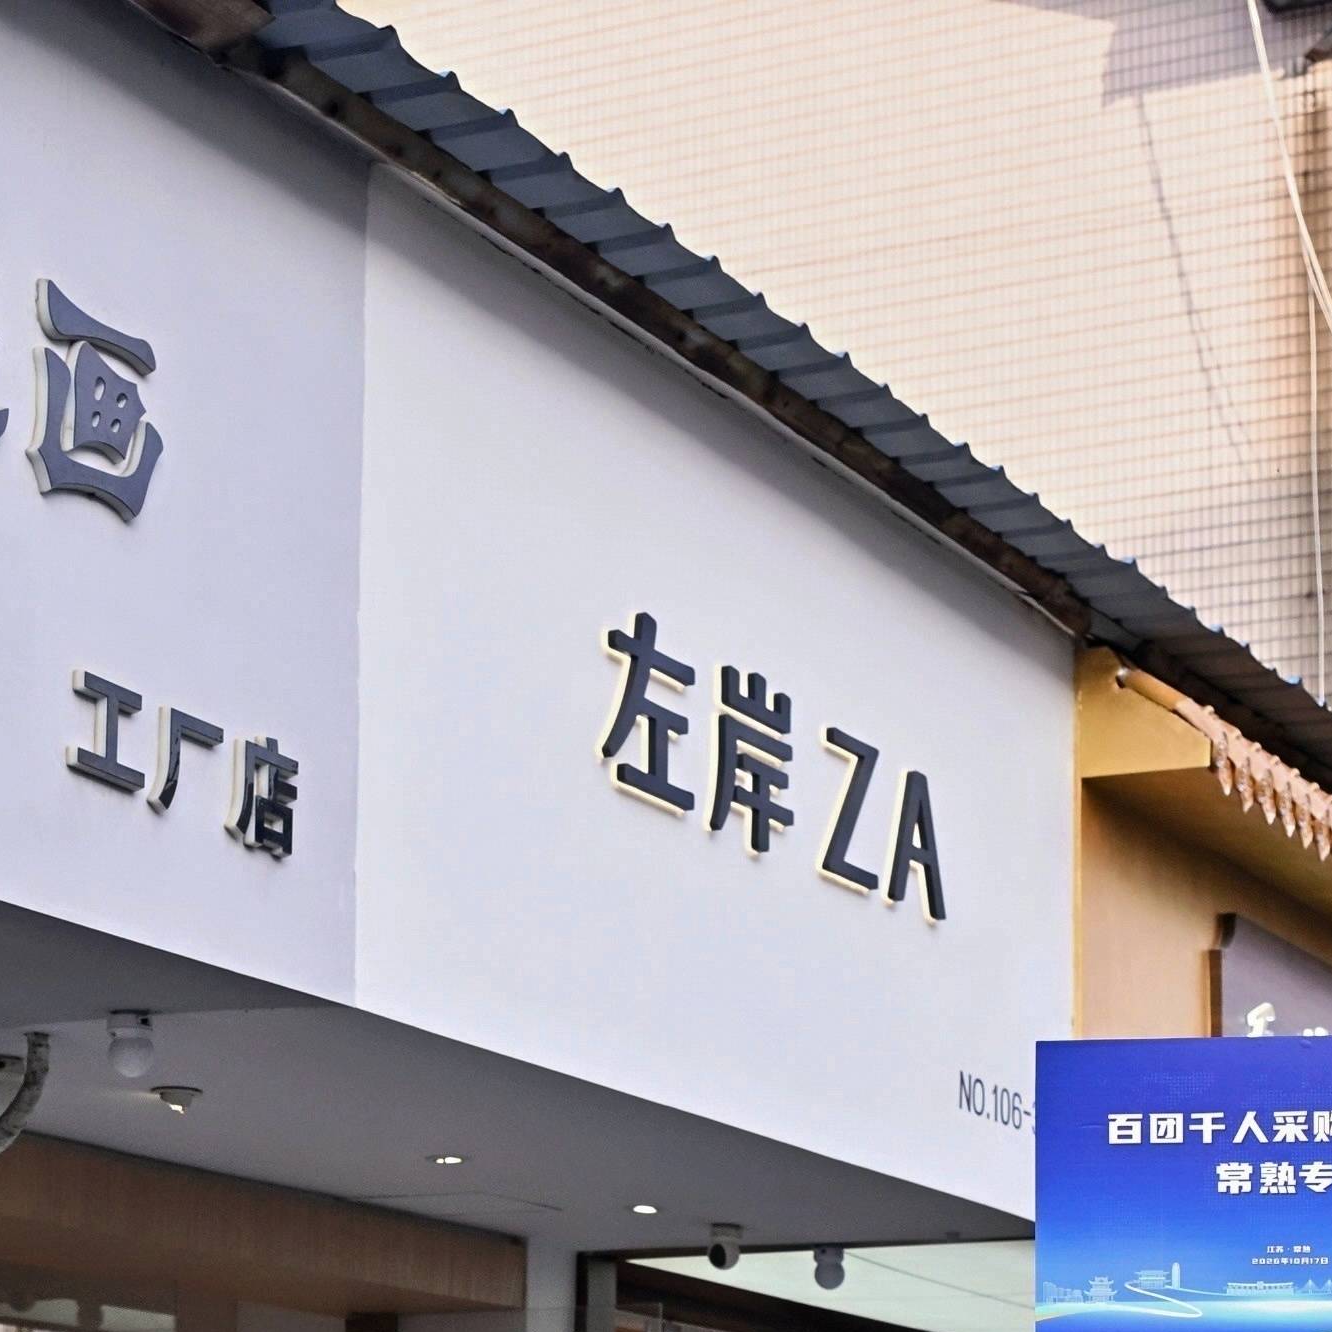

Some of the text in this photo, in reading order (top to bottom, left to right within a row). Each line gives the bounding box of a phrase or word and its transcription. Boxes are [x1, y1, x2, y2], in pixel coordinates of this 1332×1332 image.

[66, 668, 299, 860] 工厂店
[597, 611, 947, 925] 左岸 ZA
[958, 1070, 1036, 1136] NO.106-
